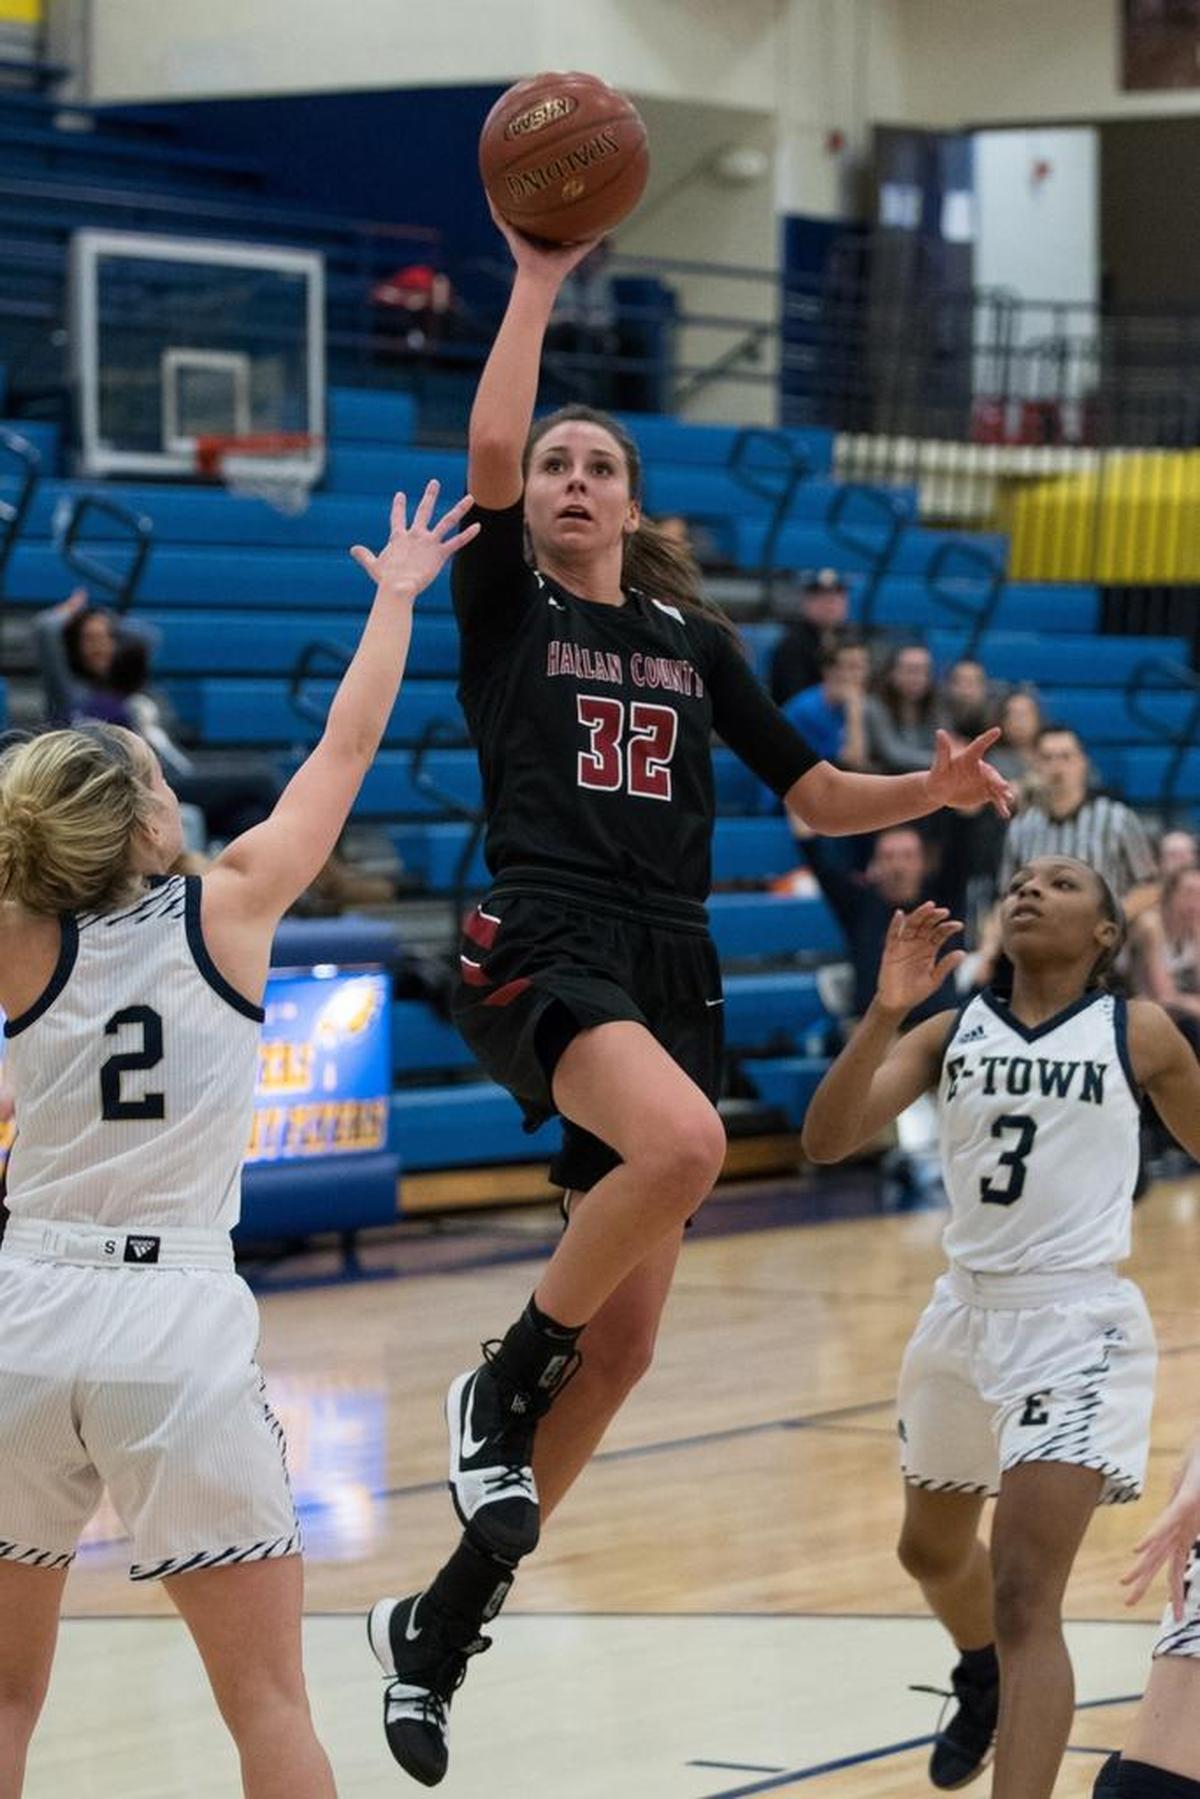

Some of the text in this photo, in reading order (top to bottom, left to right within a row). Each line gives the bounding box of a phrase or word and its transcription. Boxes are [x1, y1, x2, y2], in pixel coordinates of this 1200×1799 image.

[507, 128, 619, 196] SPALDING
[547, 640, 622, 684] HARLAN
[577, 694, 678, 801] 32
[100, 1005, 164, 1120] 2
[946, 1055, 1108, 1104] E-TOWN
[981, 1114, 1037, 1206] 3
[105, 1239, 116, 1255] S
[1019, 1388, 1053, 1426] E
